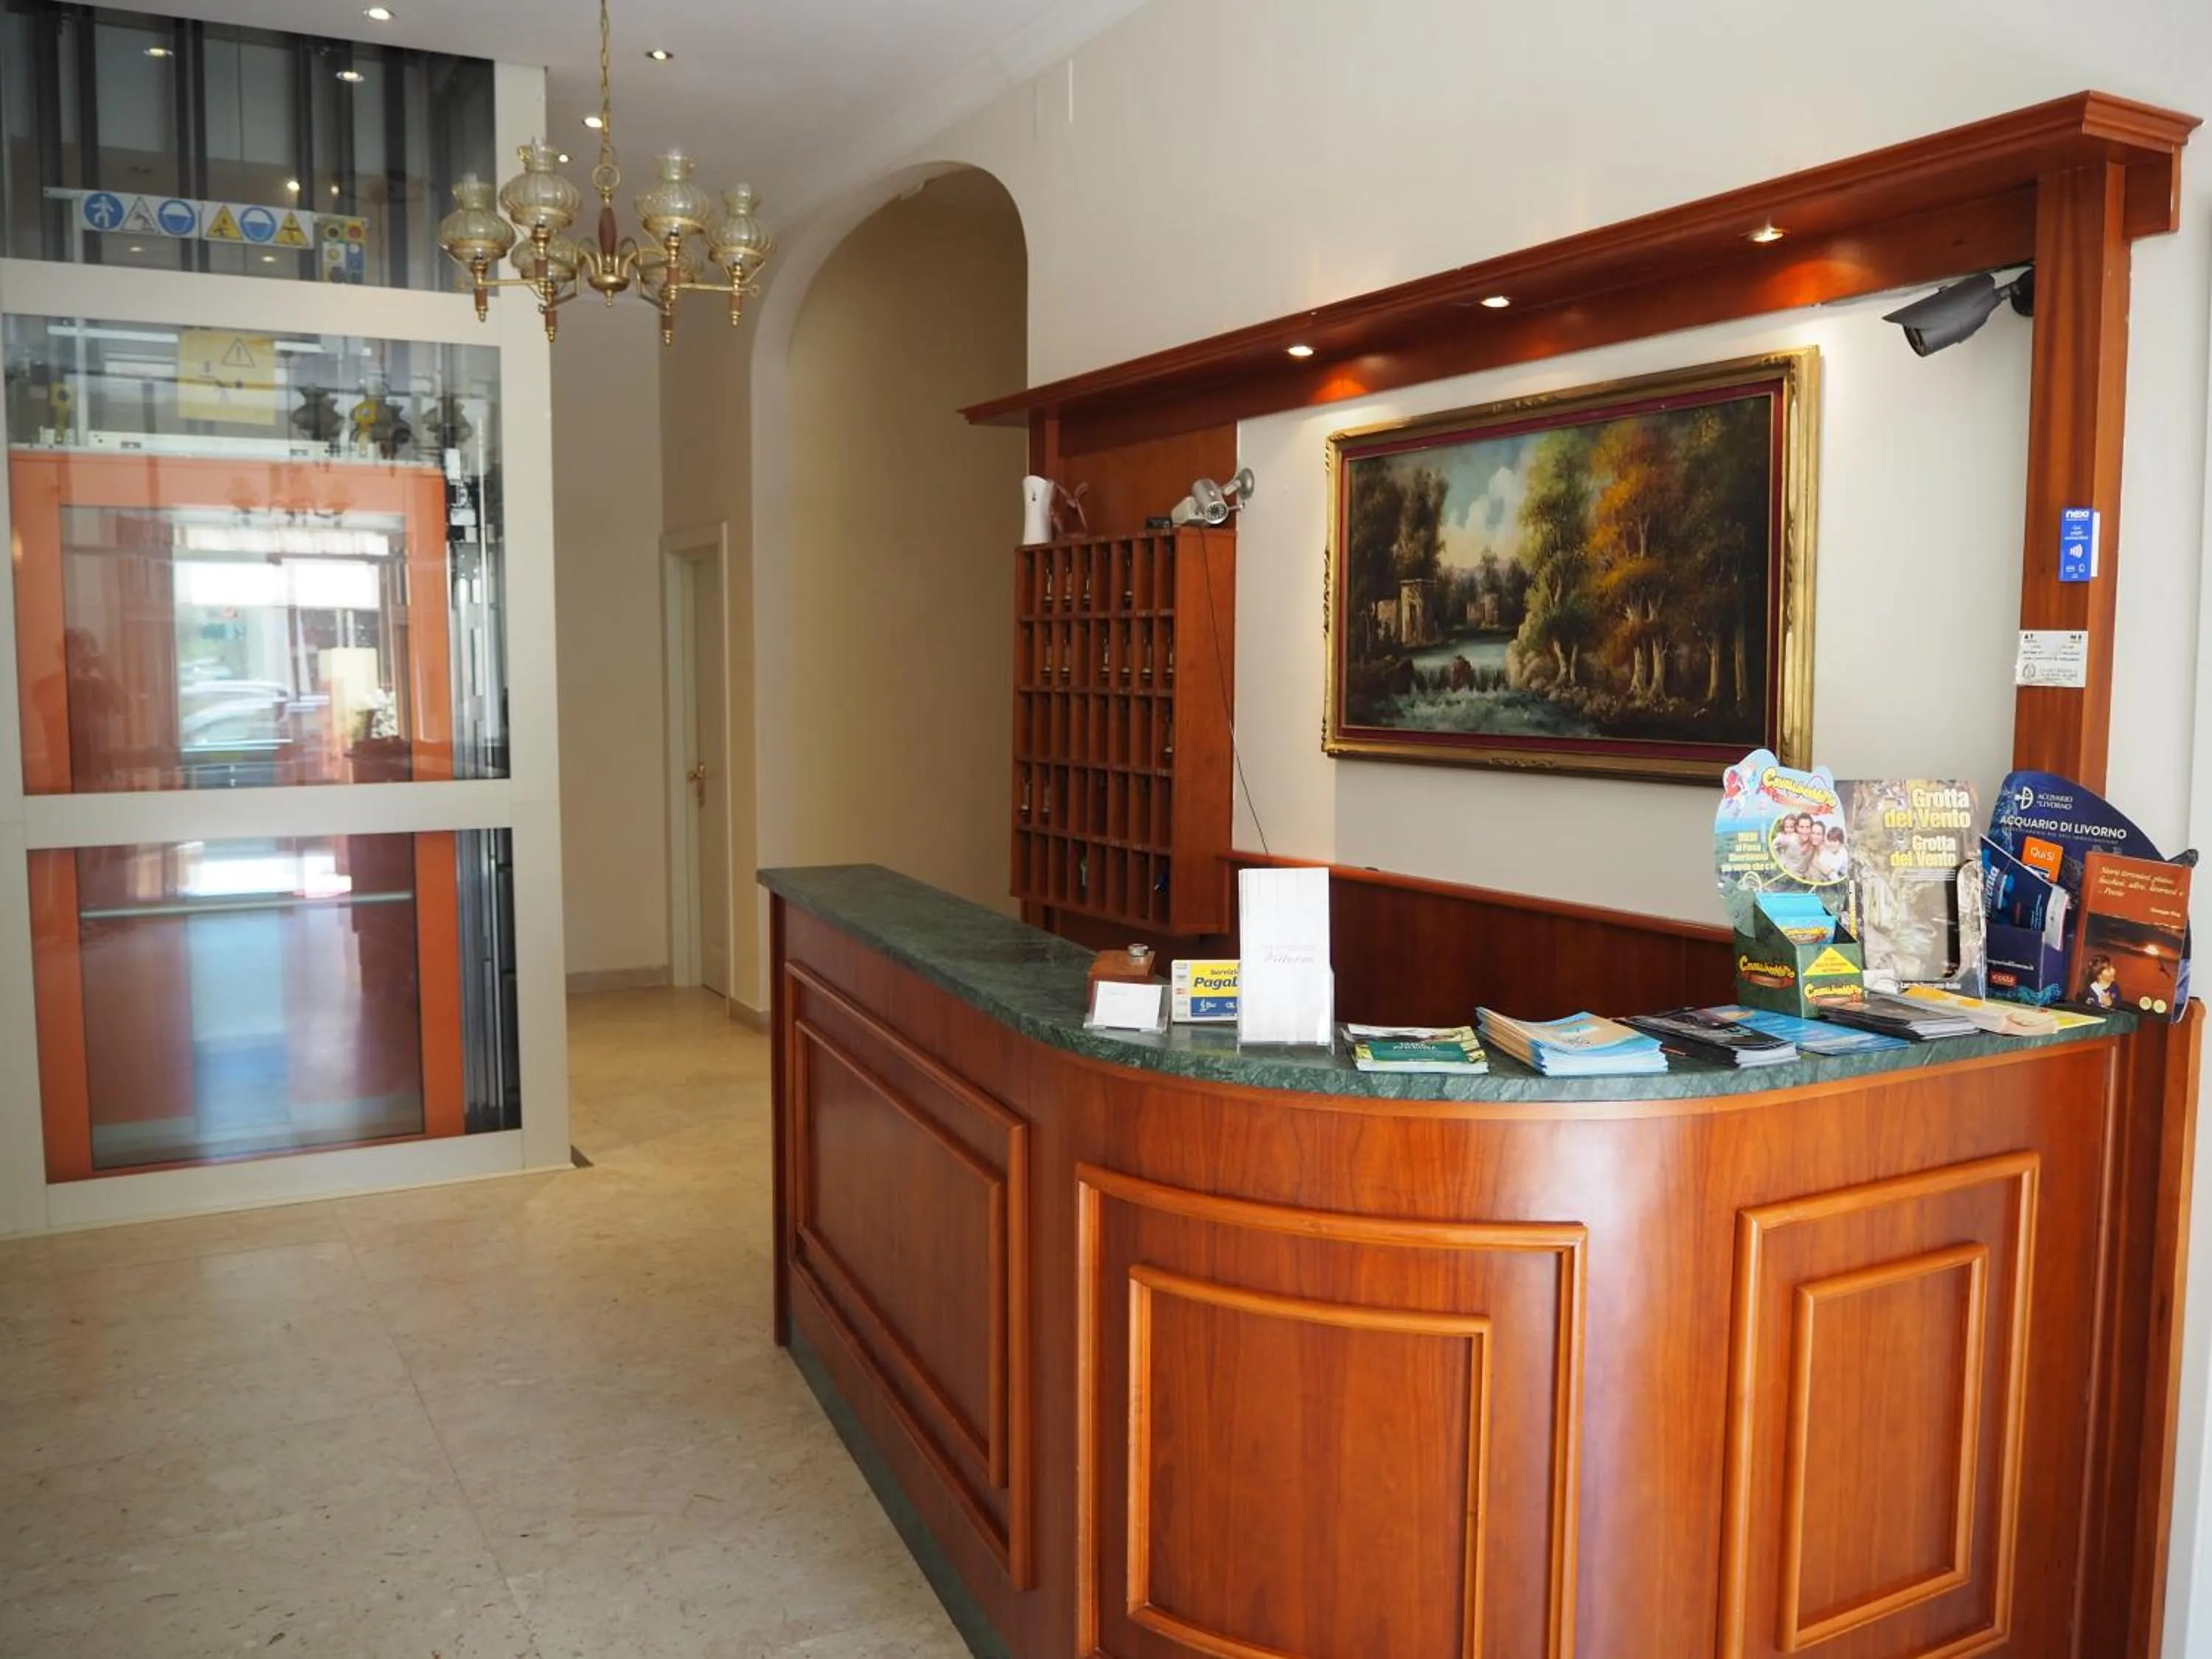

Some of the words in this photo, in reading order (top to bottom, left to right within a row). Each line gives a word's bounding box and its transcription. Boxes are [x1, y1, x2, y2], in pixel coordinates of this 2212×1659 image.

[1911, 788, 1969, 808] Grotta
[1885, 808, 1913, 828] del
[1916, 809, 1971, 828] Vento
[2000, 815, 2058, 831] ACQUARIO
[2059, 822, 2073, 832] DI
[2074, 824, 2127, 840] LIVORNO
[1912, 835, 1956, 852] Grotta
[1890, 851, 1913, 866] del
[1916, 851, 1957, 866] Vento
